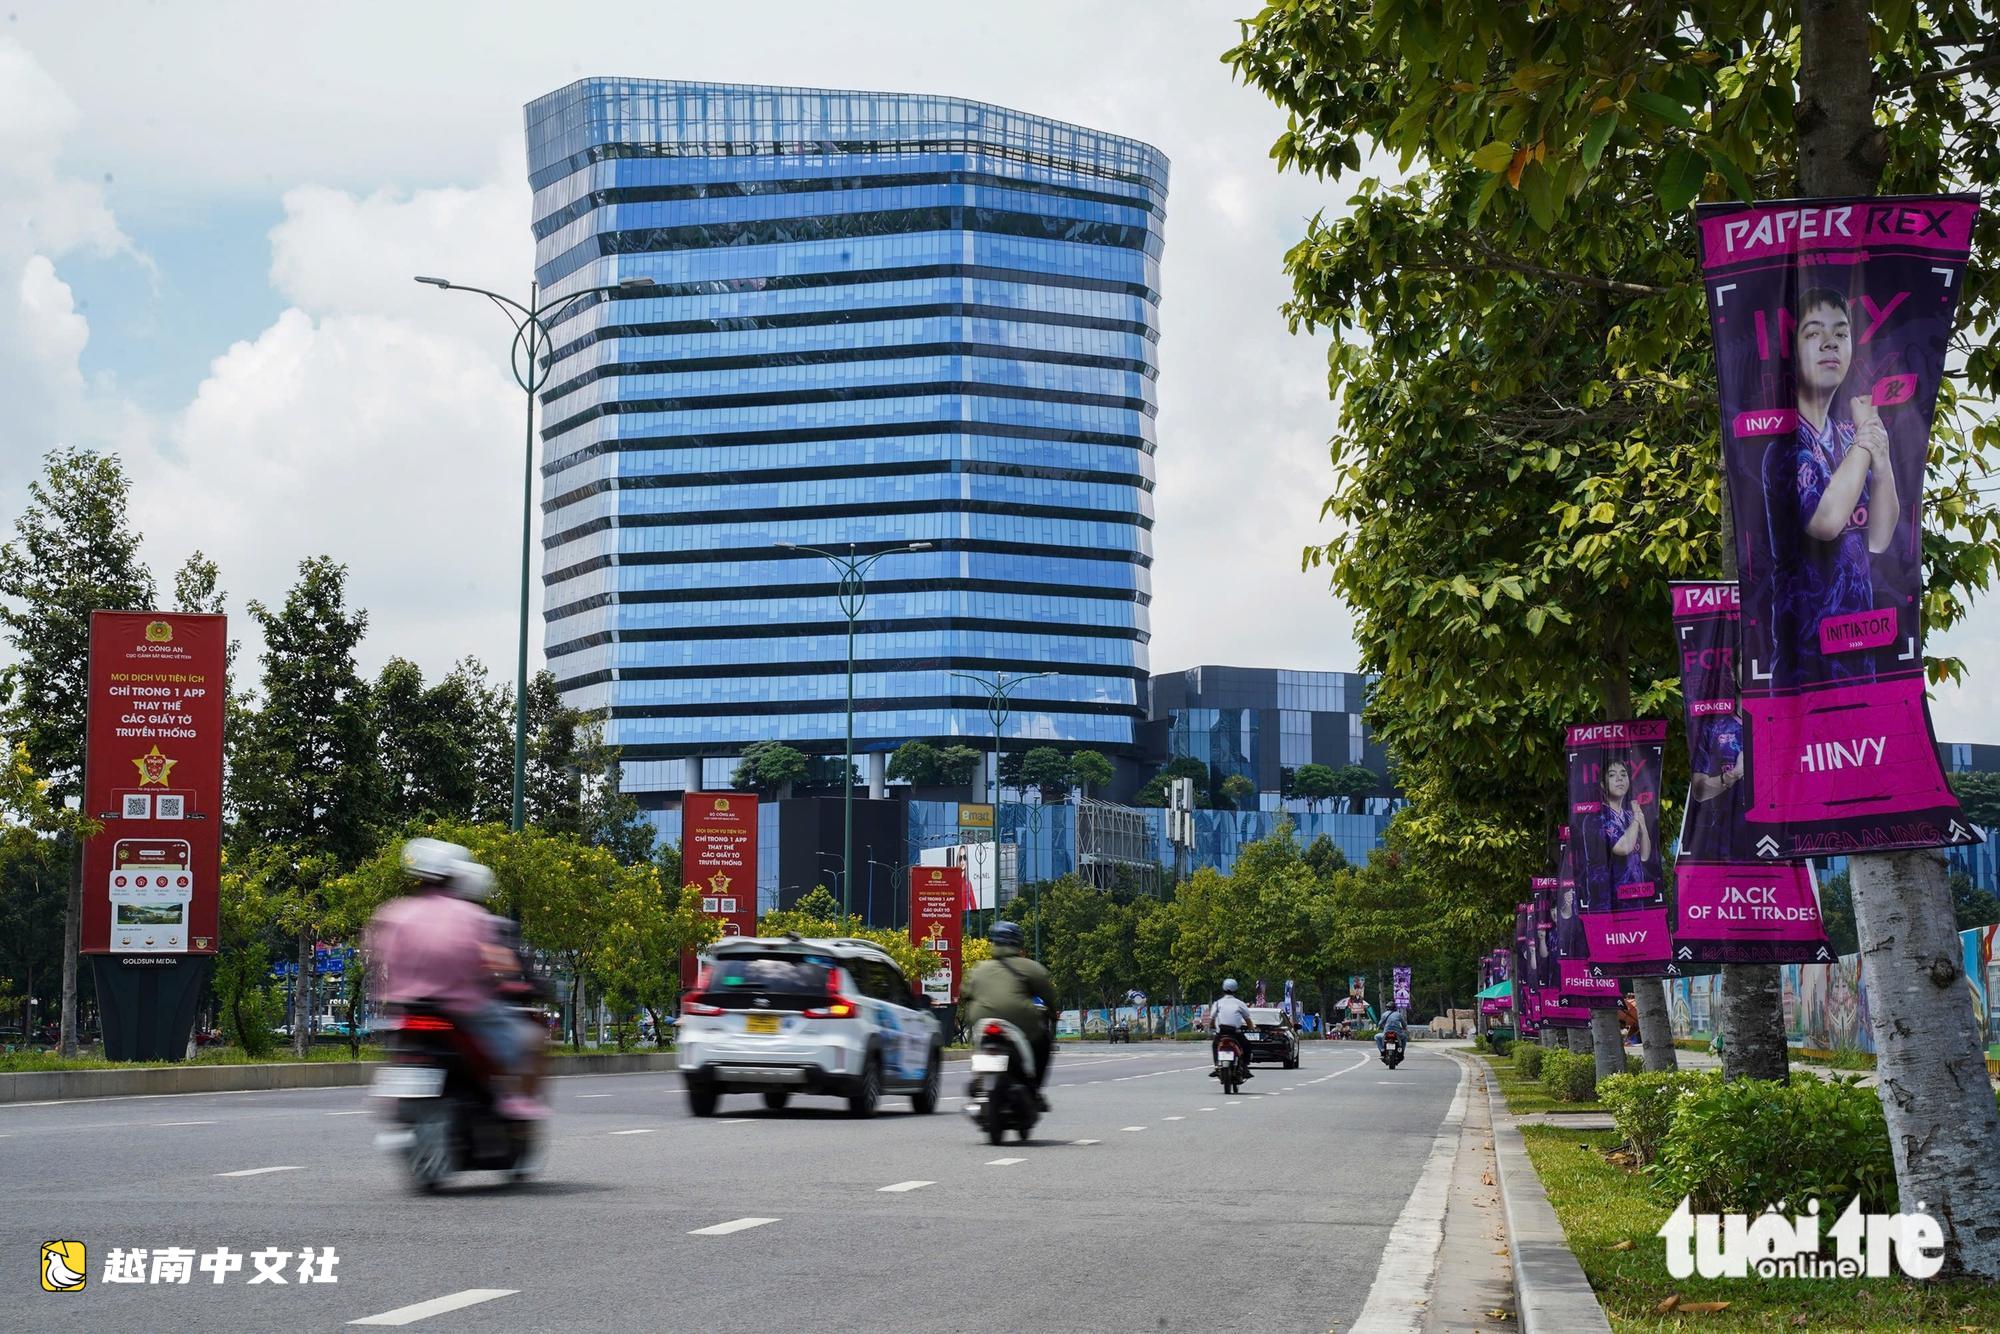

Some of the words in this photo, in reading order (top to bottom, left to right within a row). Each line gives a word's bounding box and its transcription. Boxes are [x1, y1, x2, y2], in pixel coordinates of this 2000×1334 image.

[1724, 206, 1853, 252] PAPER
[1865, 206, 1952, 238] REX
[1746, 415, 1784, 432] INVY
[1685, 586, 1741, 608] PAPE
[1826, 617, 1890, 642] INITIATOR
[111, 673, 129, 682] MỌI
[131, 673, 153, 682] DỊCH
[168, 673, 187, 683] TIỆN
[188, 674, 204, 683] ÍCH
[109, 684, 130, 696] CHỈ
[132, 687, 171, 697] TRONG
[174, 688, 180, 697] 1
[183, 688, 206, 698] APP
[133, 701, 160, 711] THAY
[161, 699, 182, 711] THẾ
[121, 713, 146, 724] CÁC
[148, 711, 175, 724] GIẤY
[177, 714, 193, 725] TỜ
[116, 725, 155, 737] TRUYỀN
[157, 726, 197, 738] THỐNG
[1574, 725, 1624, 741] PAPER
[1628, 723, 1660, 736] REX
[962, 810, 989, 821] emart
[1537, 877, 1557, 886] PAPE
[1721, 887, 1777, 904] JACK
[1688, 905, 1712, 919] OF
[1718, 906, 1746, 919] ALL
[1752, 906, 1818, 921] TRADES
[1565, 977, 1594, 987] FISHER
